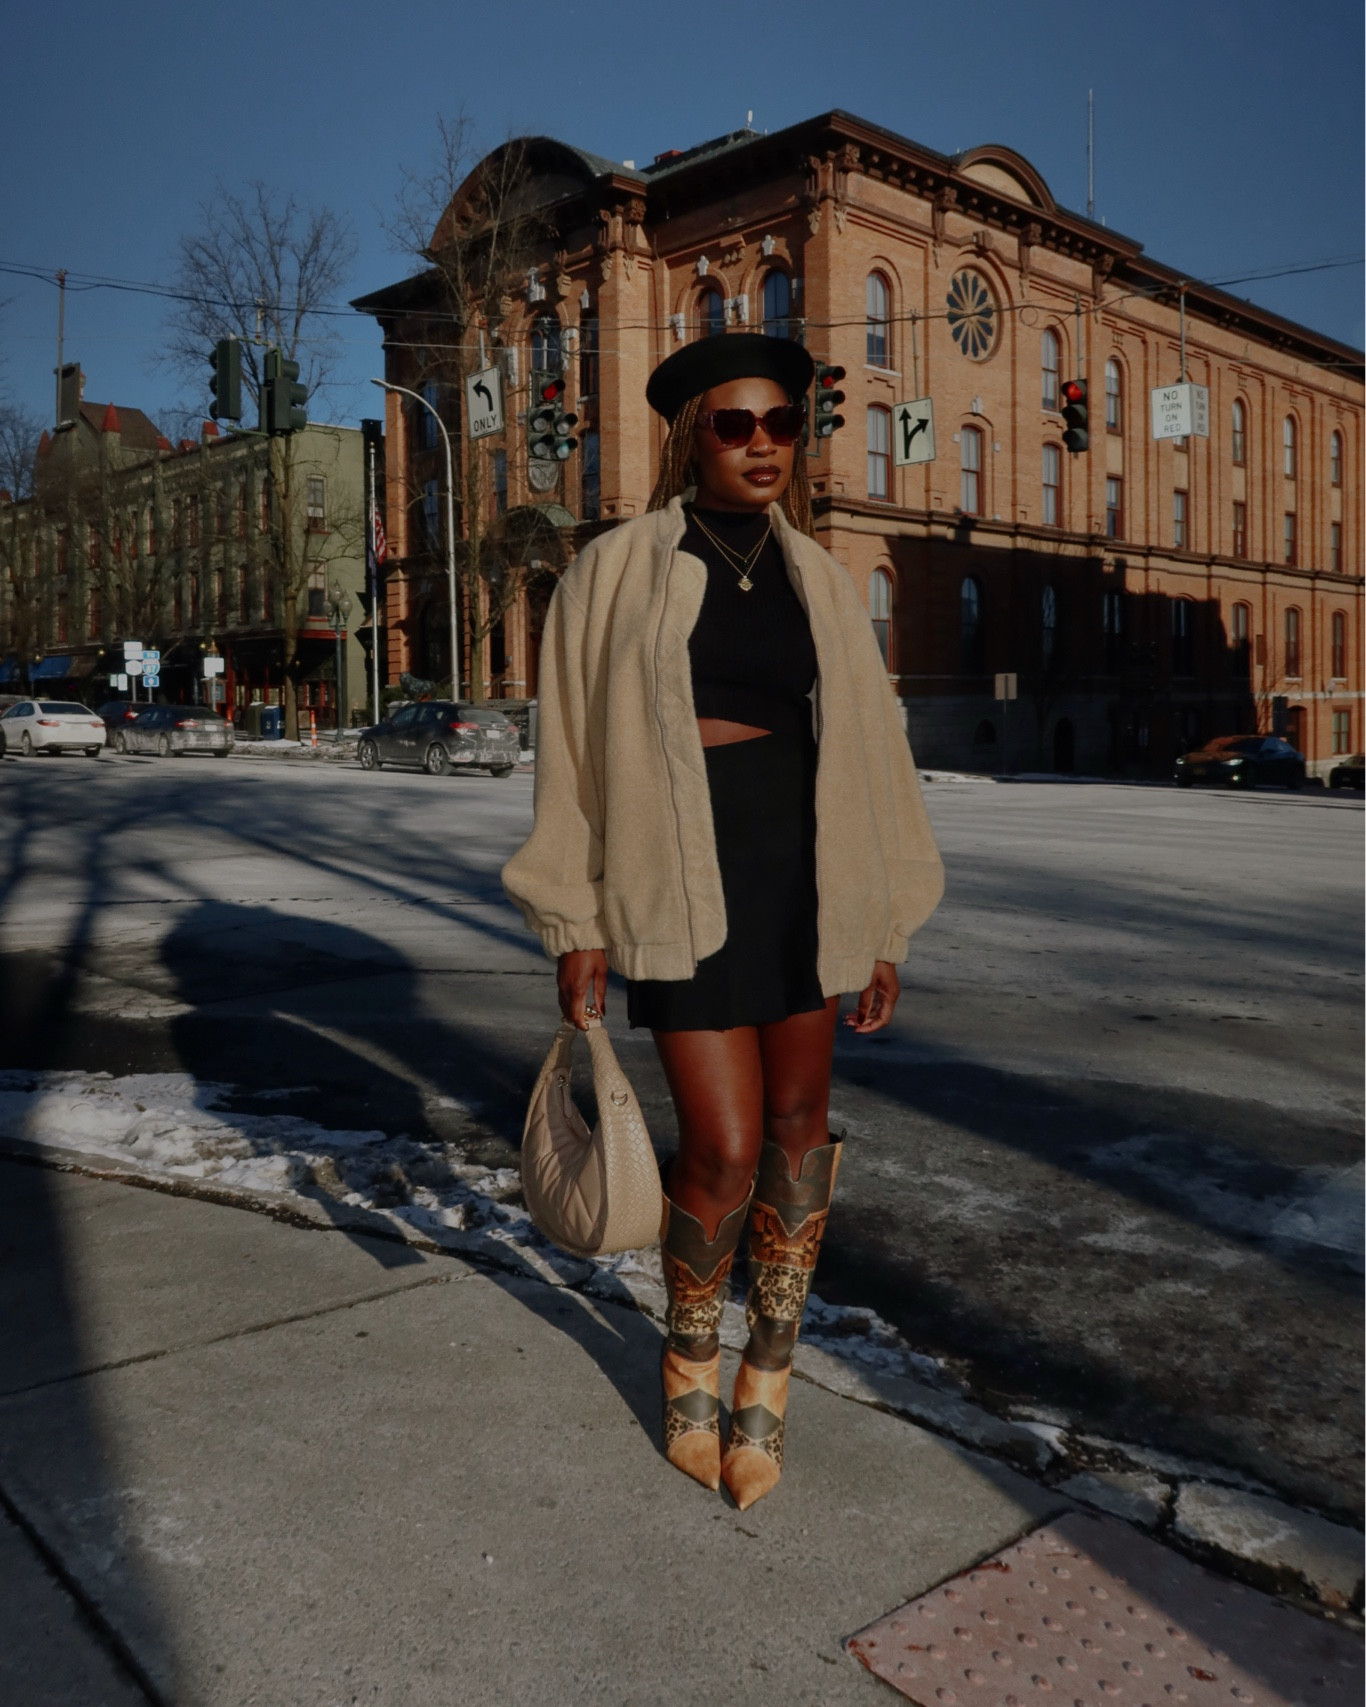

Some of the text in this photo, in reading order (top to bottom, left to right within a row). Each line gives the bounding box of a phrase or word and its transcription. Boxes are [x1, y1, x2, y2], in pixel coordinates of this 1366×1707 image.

[1163, 390, 1178, 401] NO
[1160, 402, 1182, 413] TURN
[473, 414, 497, 432] ONLY
[1165, 413, 1178, 422] ON
[1163, 423, 1181, 433] RED
